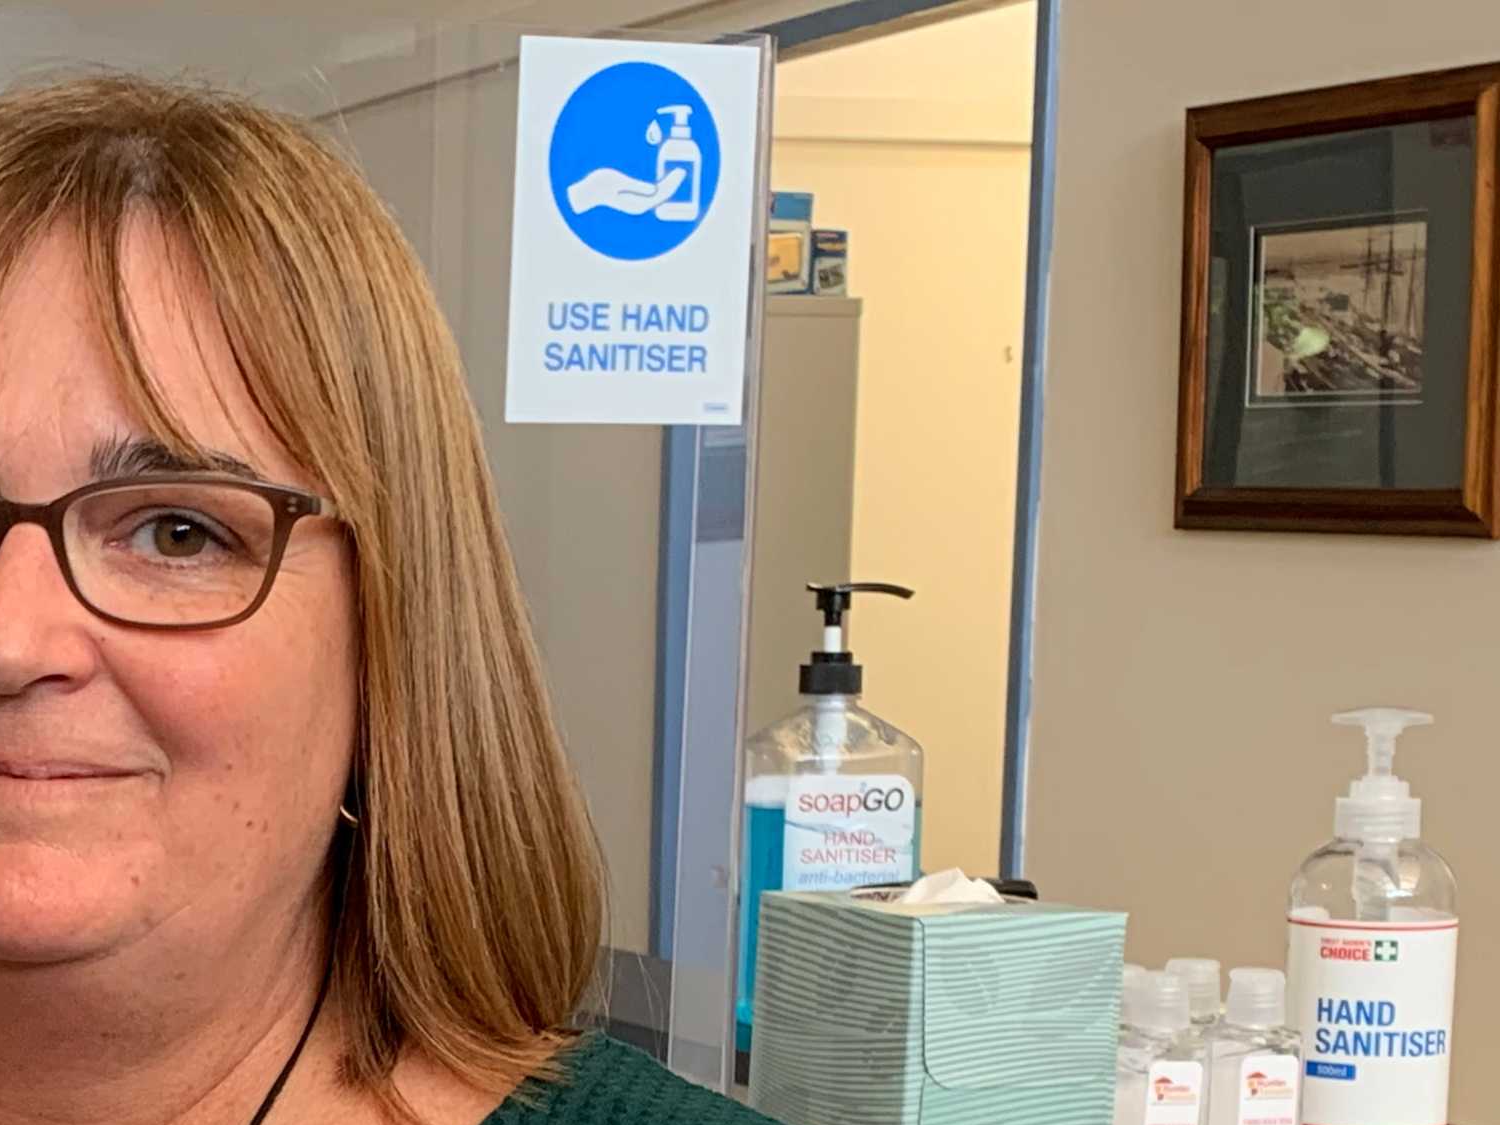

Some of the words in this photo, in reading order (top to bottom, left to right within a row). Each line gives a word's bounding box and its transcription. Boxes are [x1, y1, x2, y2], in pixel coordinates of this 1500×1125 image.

[547, 302, 610, 331] USE
[621, 303, 709, 333] HAND
[543, 342, 708, 373] SANITISER
[823, 831, 876, 846] HAND
[800, 848, 897, 865] SANITISER
[1320, 946, 1371, 961] CHOICE
[1316, 997, 1396, 1027] HAND
[1315, 1027, 1447, 1058] SANITISER
